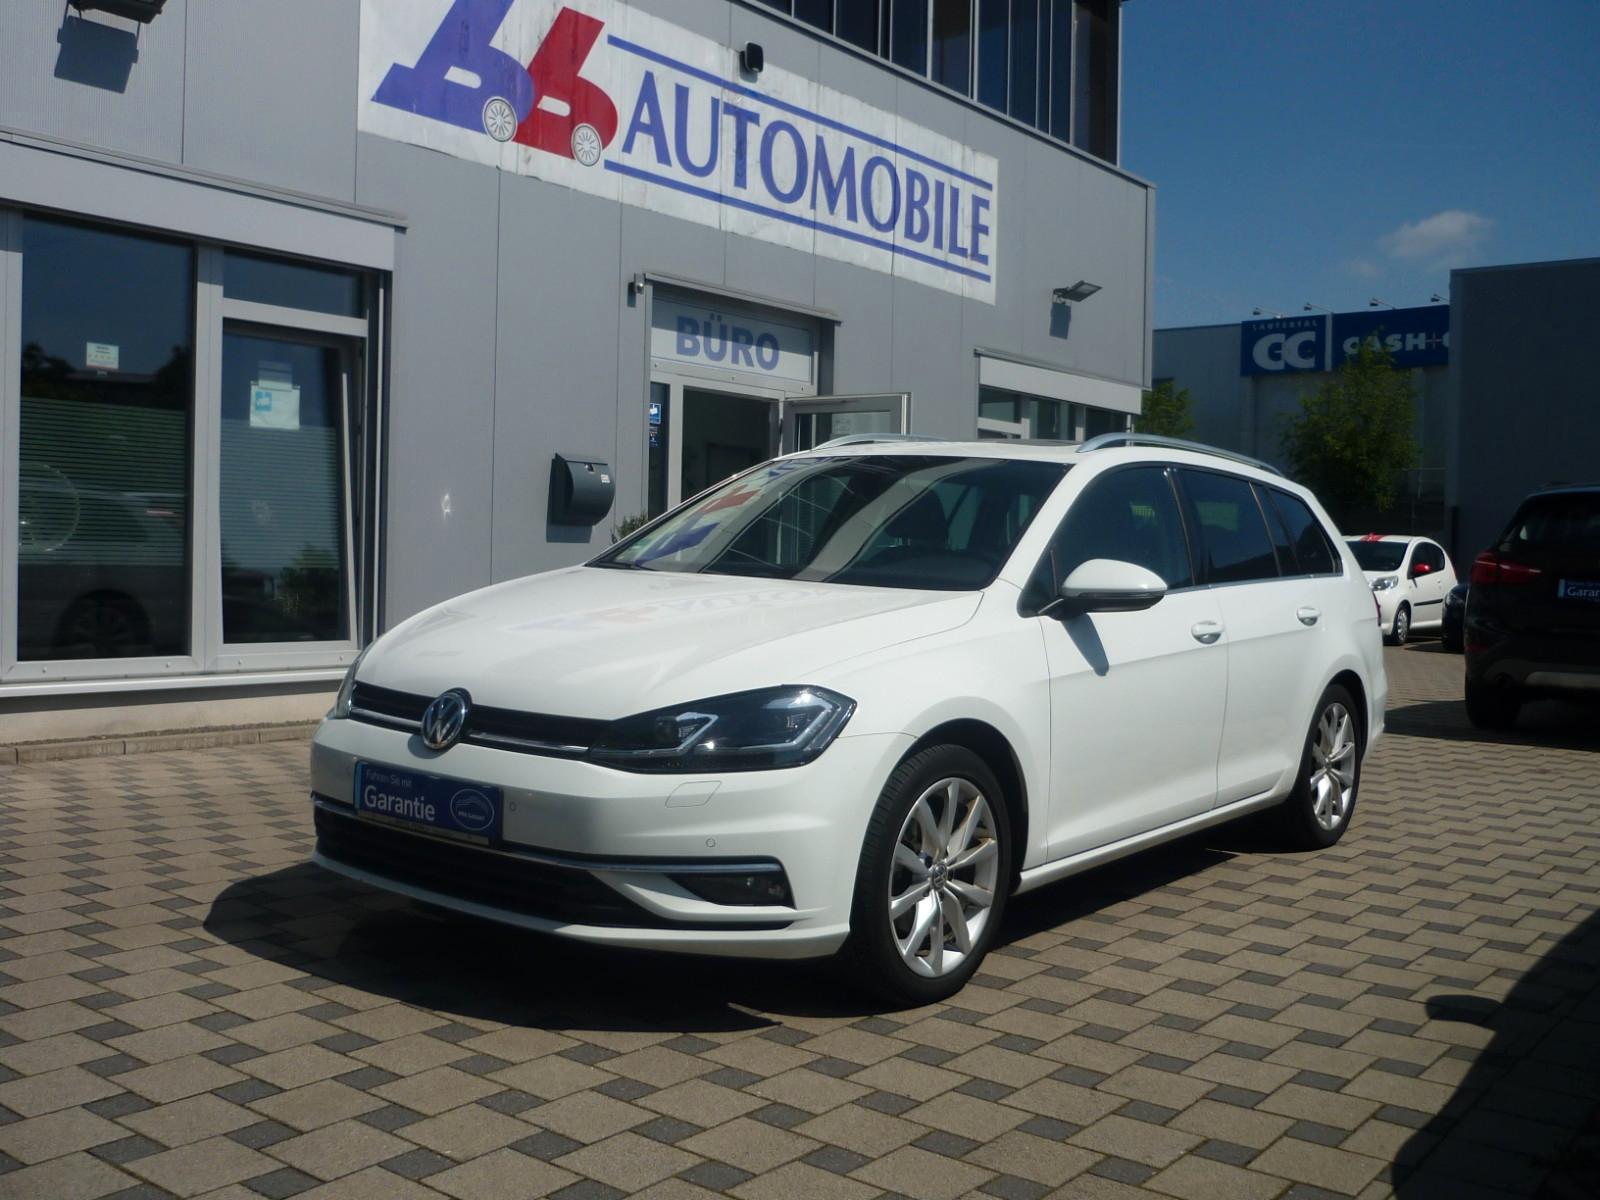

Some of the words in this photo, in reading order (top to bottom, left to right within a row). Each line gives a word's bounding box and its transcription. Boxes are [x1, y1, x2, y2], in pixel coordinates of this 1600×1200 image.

[621, 70, 990, 266] AUTOMOBILE
[676, 313, 779, 371] BÜRO
[364, 785, 435, 821] Garantie
